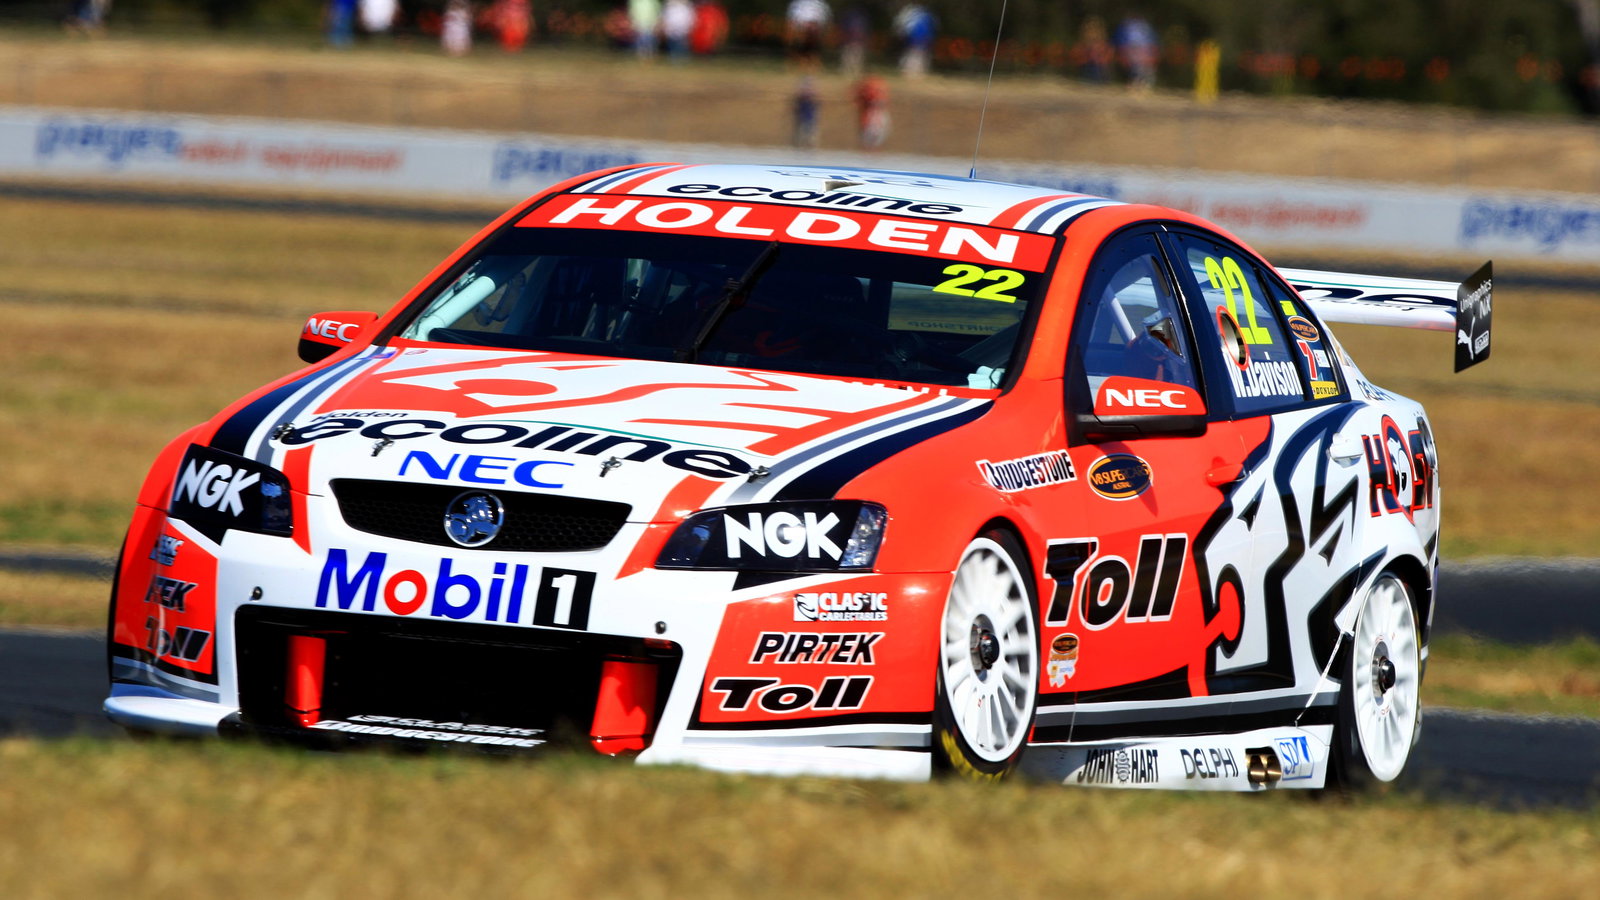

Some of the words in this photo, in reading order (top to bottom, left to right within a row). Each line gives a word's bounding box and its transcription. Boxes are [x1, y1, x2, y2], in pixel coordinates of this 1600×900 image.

[666, 182, 963, 215] ecoline
[548, 197, 1020, 264] HOLDEN
[933, 264, 1025, 304] 22
[1204, 257, 1273, 345] 22
[303, 318, 359, 342] NEC
[310, 411, 409, 423] Holden
[1106, 388, 1187, 409] NEC
[280, 418, 752, 479] ecoline
[175, 458, 261, 518] NGK
[398, 450, 575, 489] NEC
[977, 450, 1077, 493] BRIDGESTONE
[723, 511, 843, 561] NGK
[315, 548, 529, 623] Mobil
[1044, 533, 1188, 631] Toll
[749, 631, 885, 665] PIRTEK
[710, 675, 874, 714] Toll
[1077, 748, 1114, 784] JOHN
[1131, 748, 1158, 783] HART
[1180, 747, 1239, 779] DELPHI
